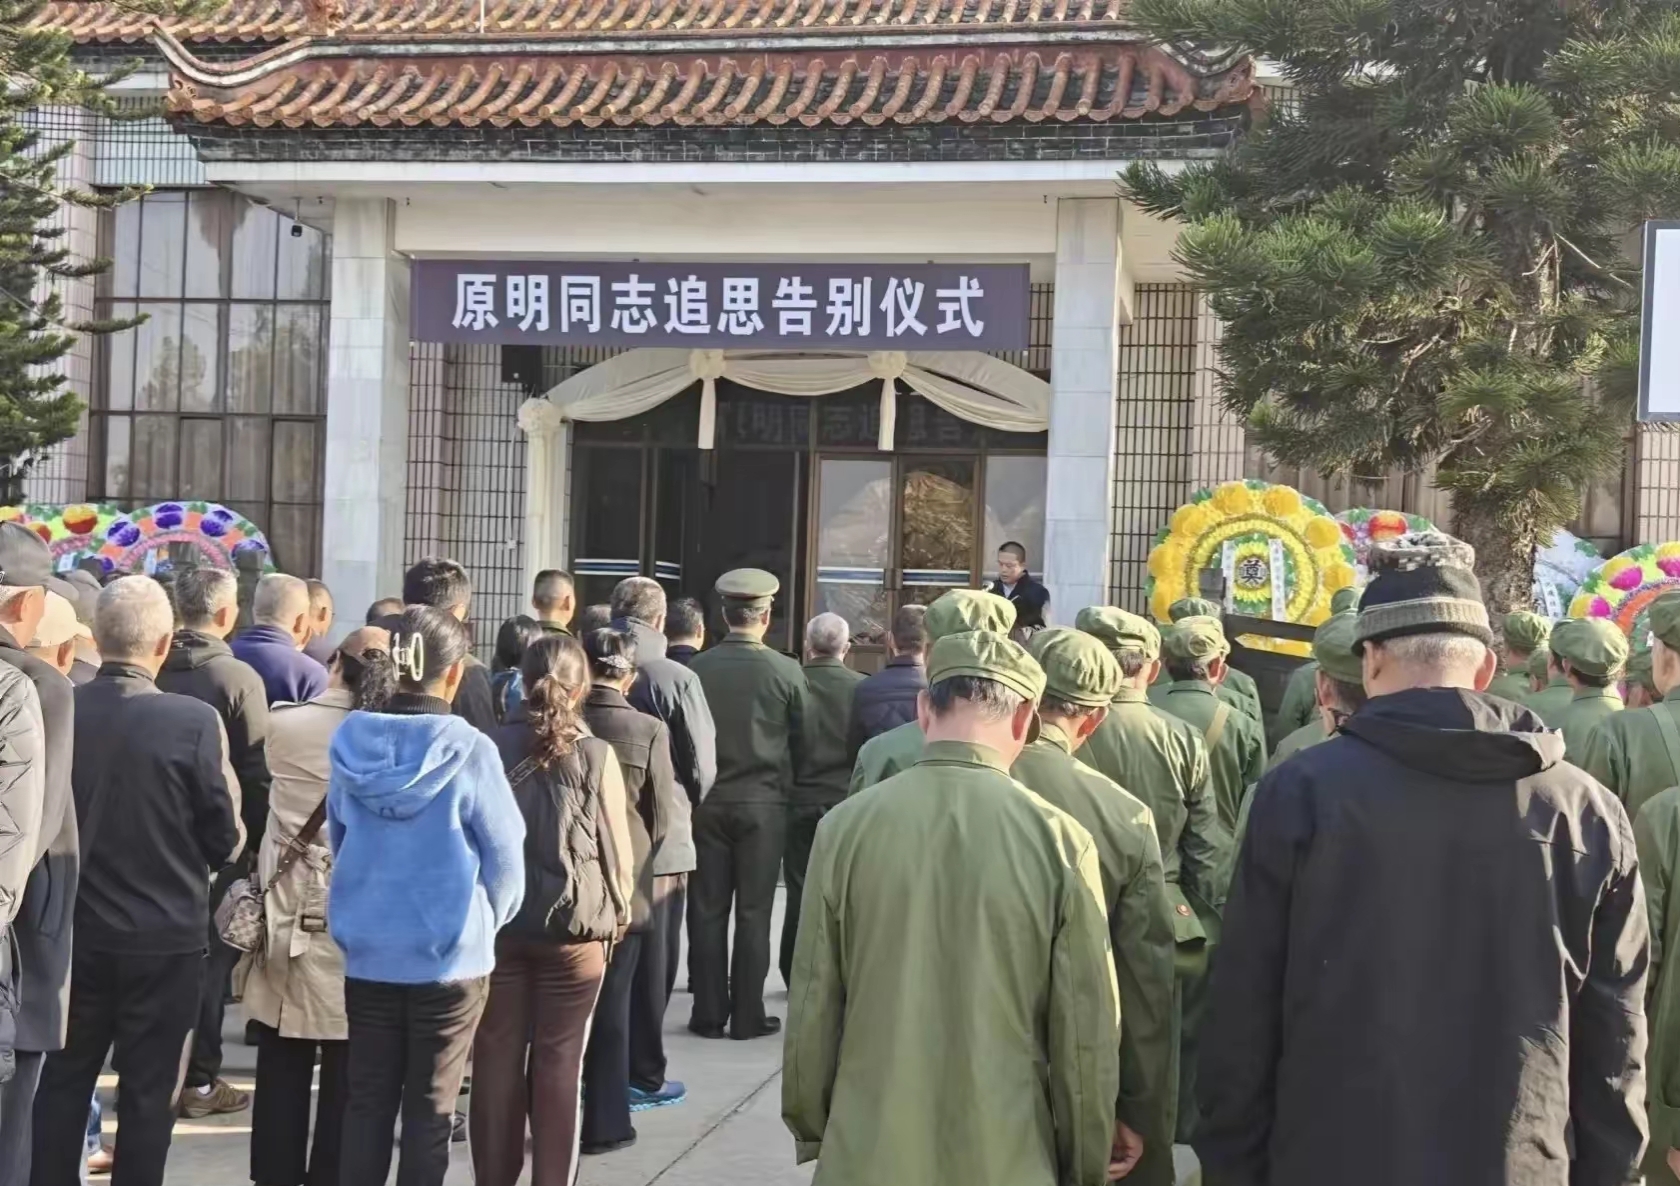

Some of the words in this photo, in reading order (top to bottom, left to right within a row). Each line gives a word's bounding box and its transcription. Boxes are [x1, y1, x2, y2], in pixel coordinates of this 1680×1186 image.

[452, 273, 985, 337] 原明同志追思告别仪式
[1241, 559, 1263, 585] 奠
